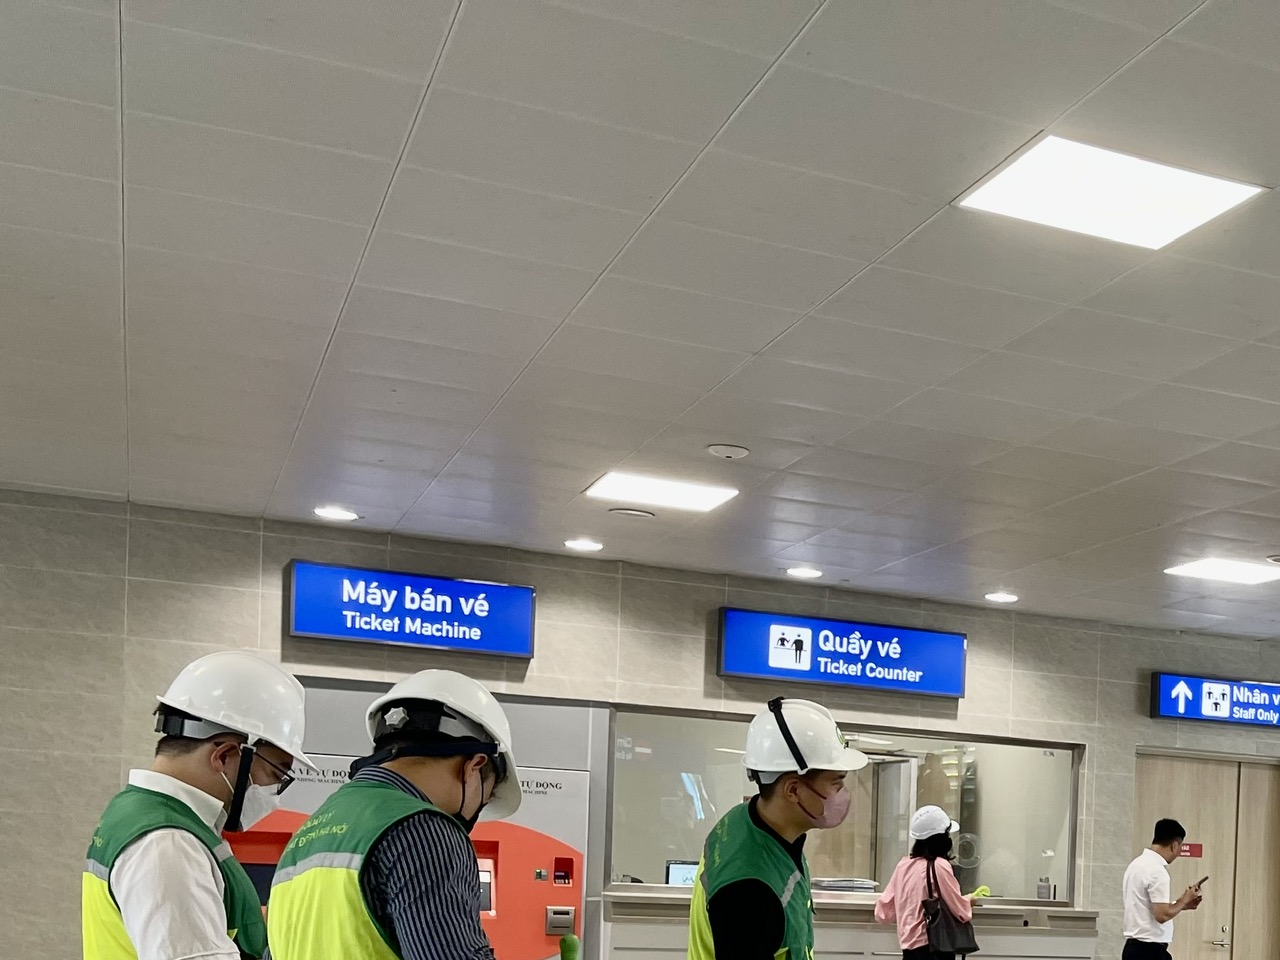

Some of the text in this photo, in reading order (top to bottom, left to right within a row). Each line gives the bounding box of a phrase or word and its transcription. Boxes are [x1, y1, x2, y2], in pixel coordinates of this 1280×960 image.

[342, 579, 490, 617] Máy bán vé
[342, 611, 482, 640] Ticket Machine
[818, 629, 902, 660] Quầy vé
[817, 657, 924, 683] Ticket Counter
[1233, 686, 1269, 705] Nhân
[1232, 706, 1280, 725] Staff Only
